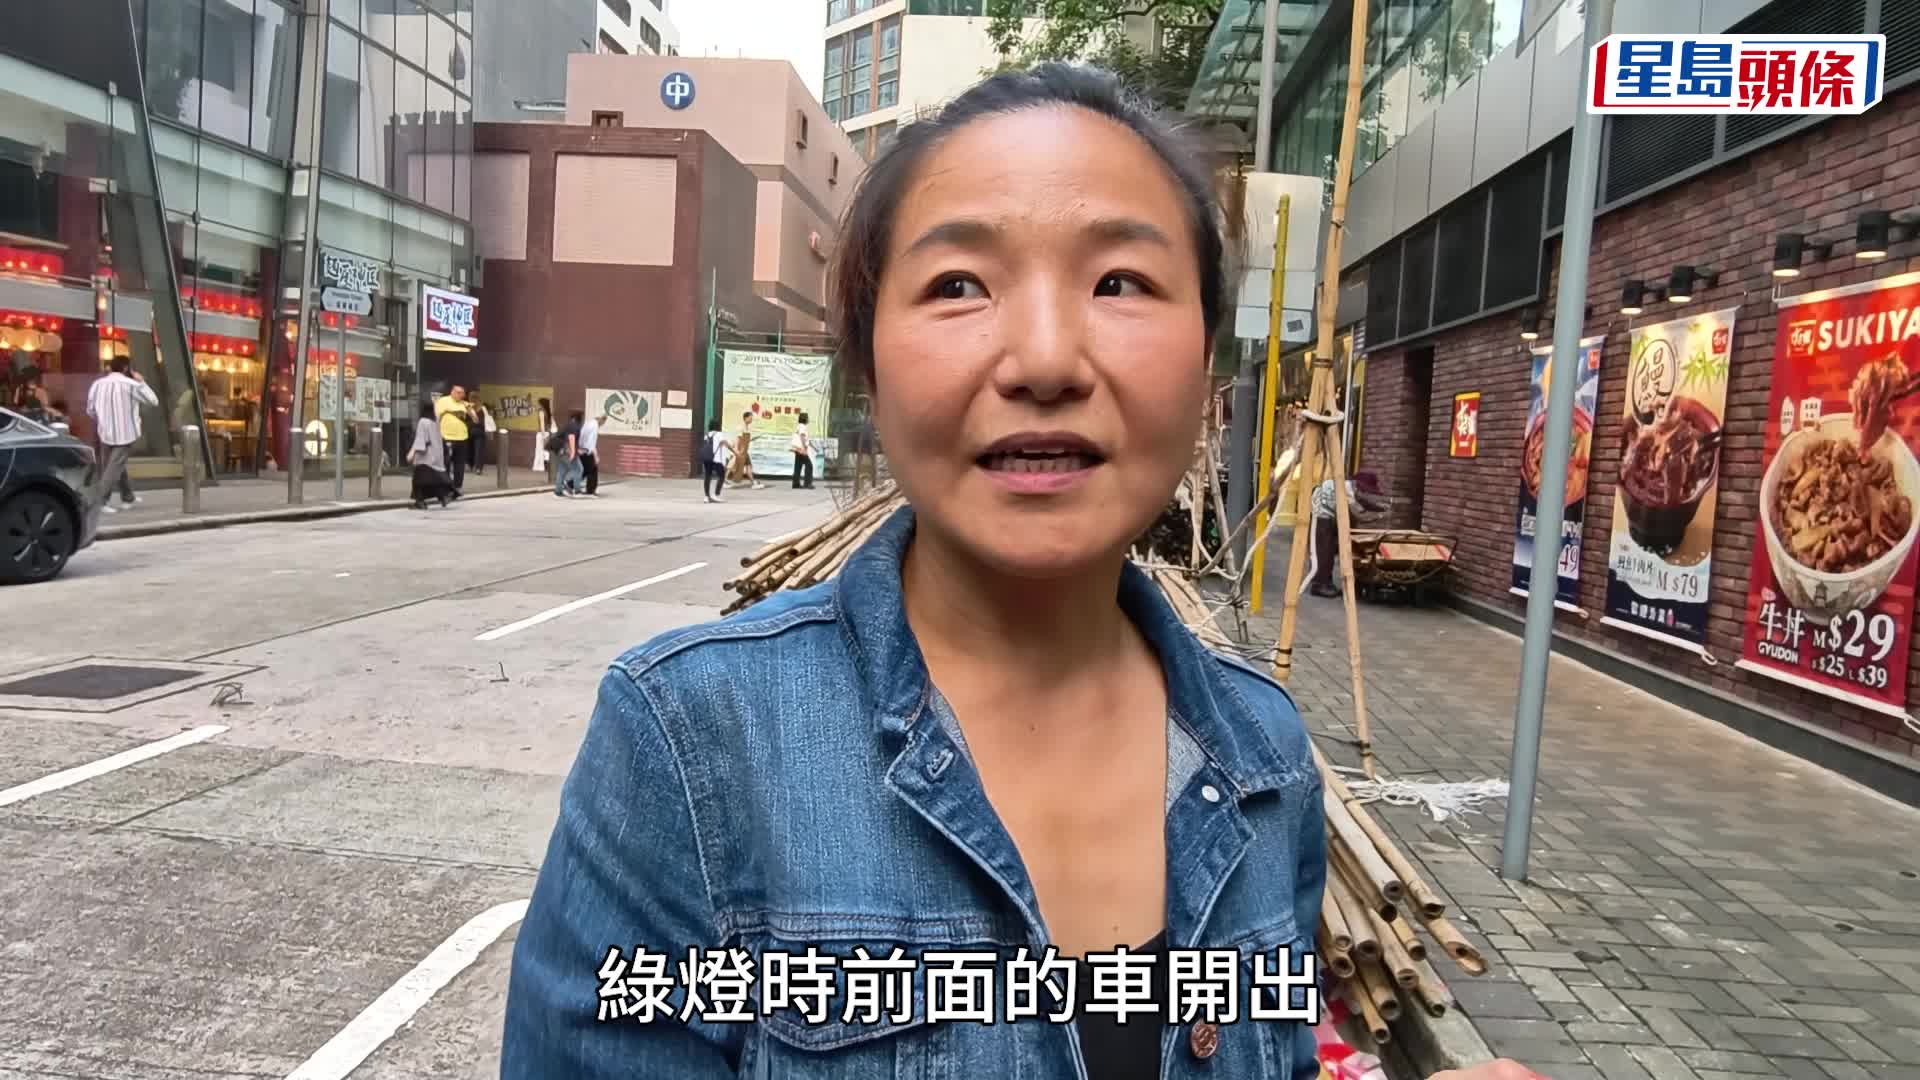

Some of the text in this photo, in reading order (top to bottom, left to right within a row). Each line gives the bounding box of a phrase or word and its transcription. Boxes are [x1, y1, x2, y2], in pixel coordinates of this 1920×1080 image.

[1817, 306, 1920, 351] SUKIYA
[1759, 602, 1805, 648] 牛丼
[1812, 609, 1896, 662] M $29
[1758, 642, 1799, 664] GYUDON
[1819, 654, 1845, 677] $25
[1858, 664, 1888, 689] $39
